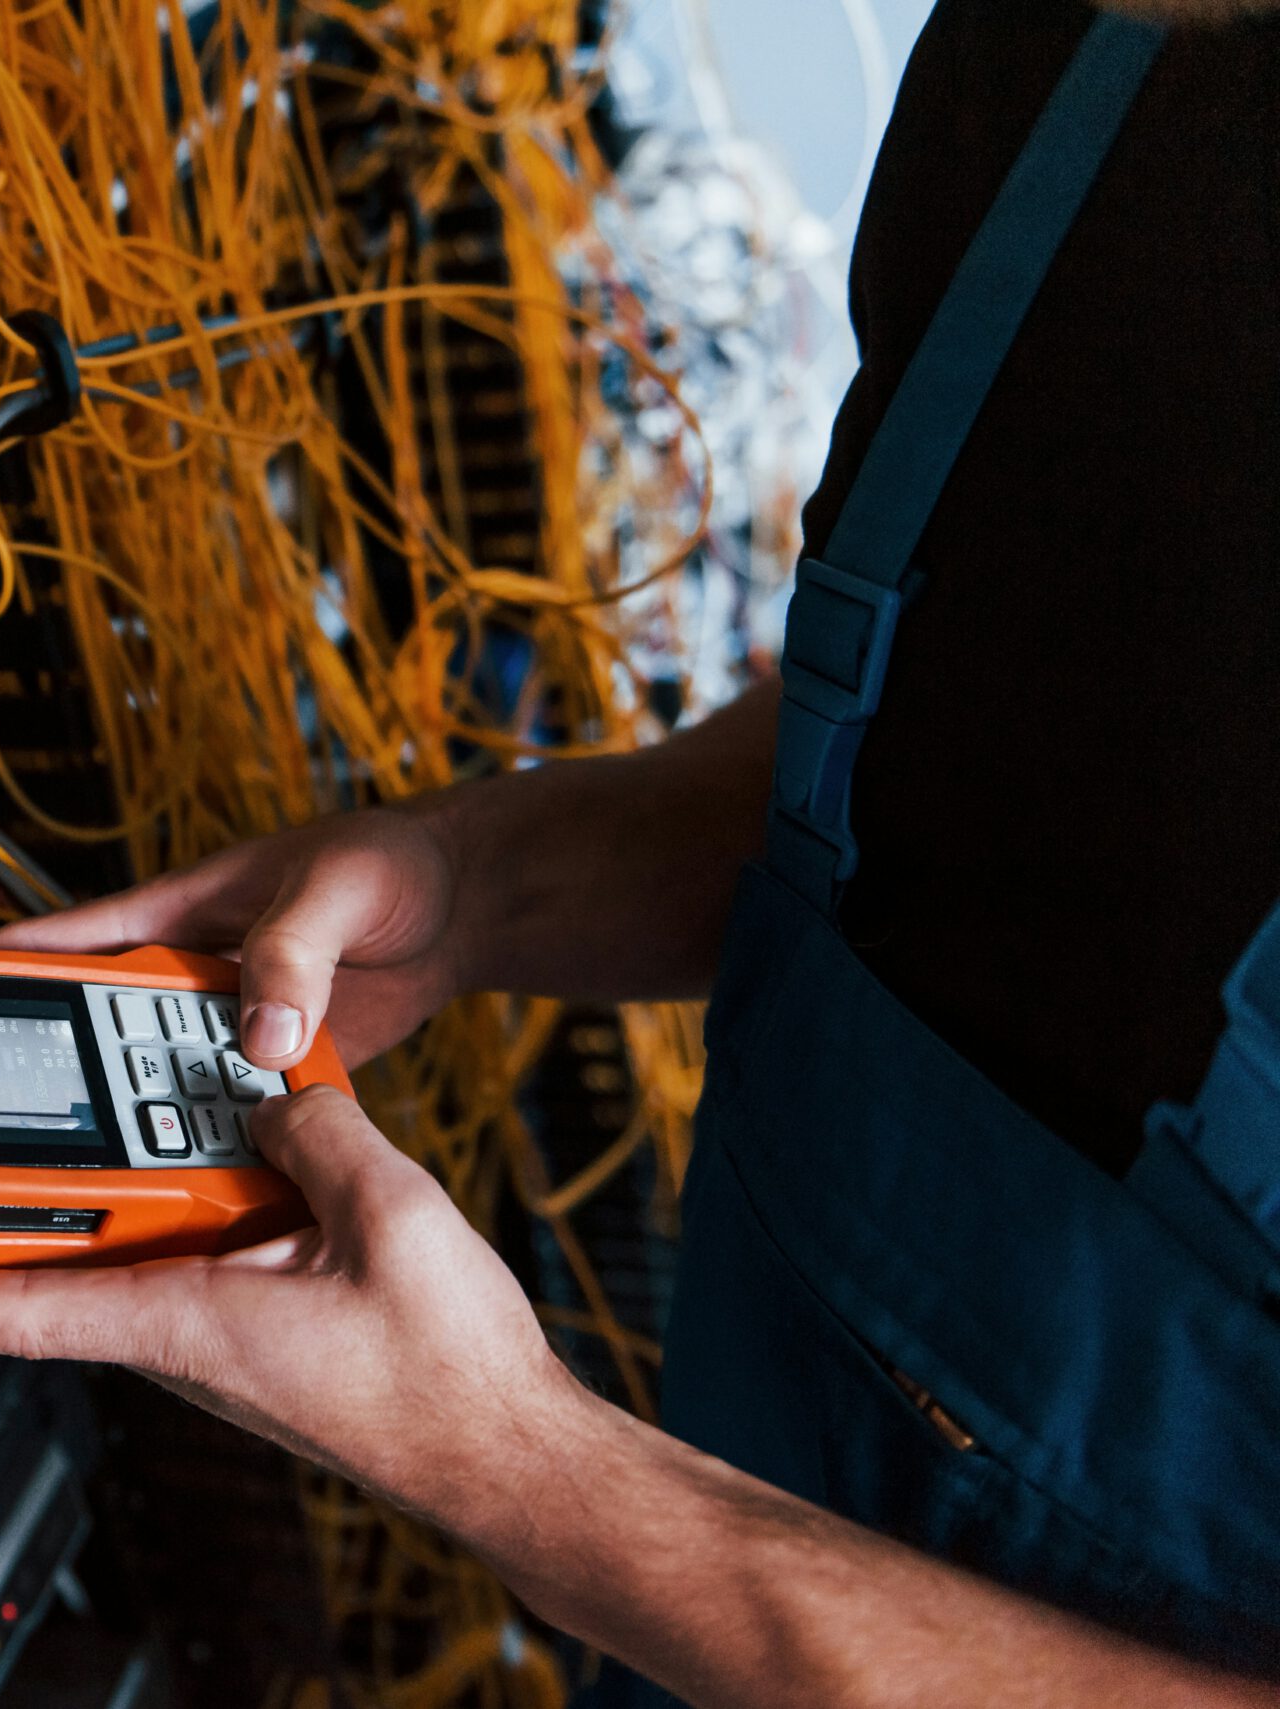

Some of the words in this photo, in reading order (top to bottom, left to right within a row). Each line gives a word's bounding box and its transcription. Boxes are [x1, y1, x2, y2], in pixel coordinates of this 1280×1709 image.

[173, 998, 188, 1033] Threshold
[141, 1056, 152, 1078] Mode
[150, 1061, 160, 1074] F/P
